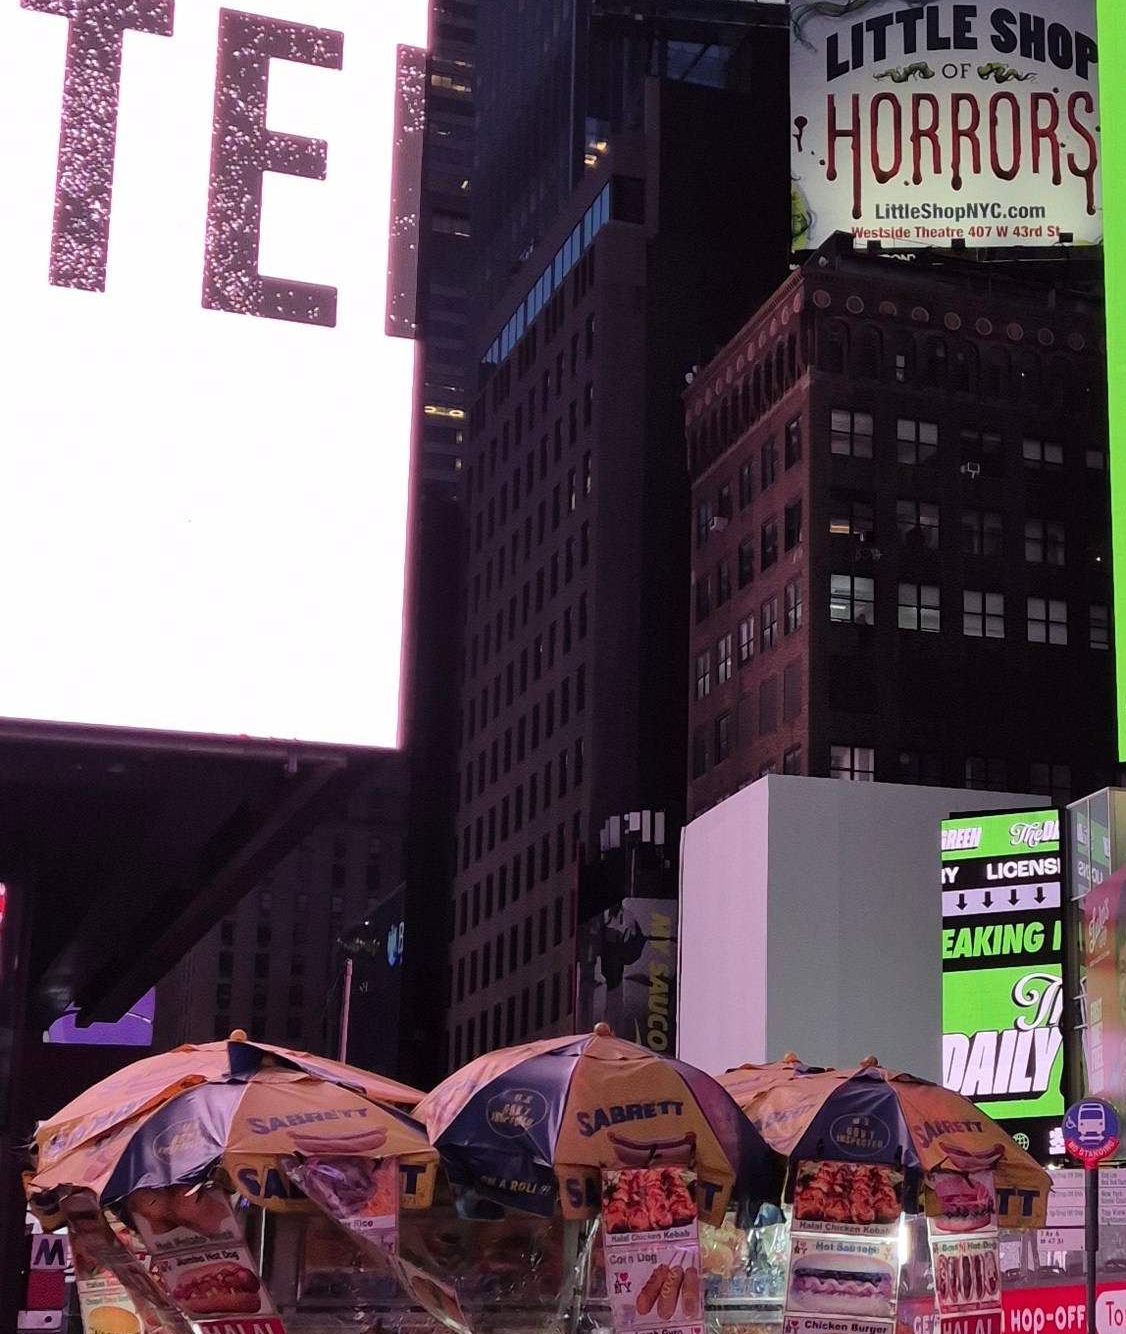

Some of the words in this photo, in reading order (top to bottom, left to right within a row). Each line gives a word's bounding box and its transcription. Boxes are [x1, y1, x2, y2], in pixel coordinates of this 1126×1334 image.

[826, 4, 978, 83] LITTLE
[990, 7, 1098, 80] SHOP
[942, 64, 972, 80] OF
[825, 89, 1097, 220] HORRORS
[874, 202, 1047, 222] LittleShopNYC.com
[851, 226, 911, 239] Westside
[914, 226, 964, 239] Theatre
[968, 226, 993, 238] 407
[996, 226, 1009, 237] W
[1012, 225, 1044, 238] 43rd
[1046, 225, 1061, 237] St
[1009, 821, 1041, 848] The
[942, 1027, 1063, 1097] DAILY
[246, 1107, 367, 1135] SABRETT
[576, 1100, 684, 1138] SABRETT
[914, 1119, 983, 1149] SABRETT
[1068, 1140, 1079, 1152] NO
[1079, 1139, 1115, 1157] STANDING
[663, 1229, 690, 1239] Kebab
[799, 1222, 823, 1231] Halal
[825, 1223, 861, 1233] Chicken
[222, 1250, 240, 1261] Dog
[610, 1254, 634, 1265] Corn
[637, 1252, 657, 1264] Dog
[805, 1320, 848, 1333] Chicken
[851, 1323, 888, 1334] Burger
